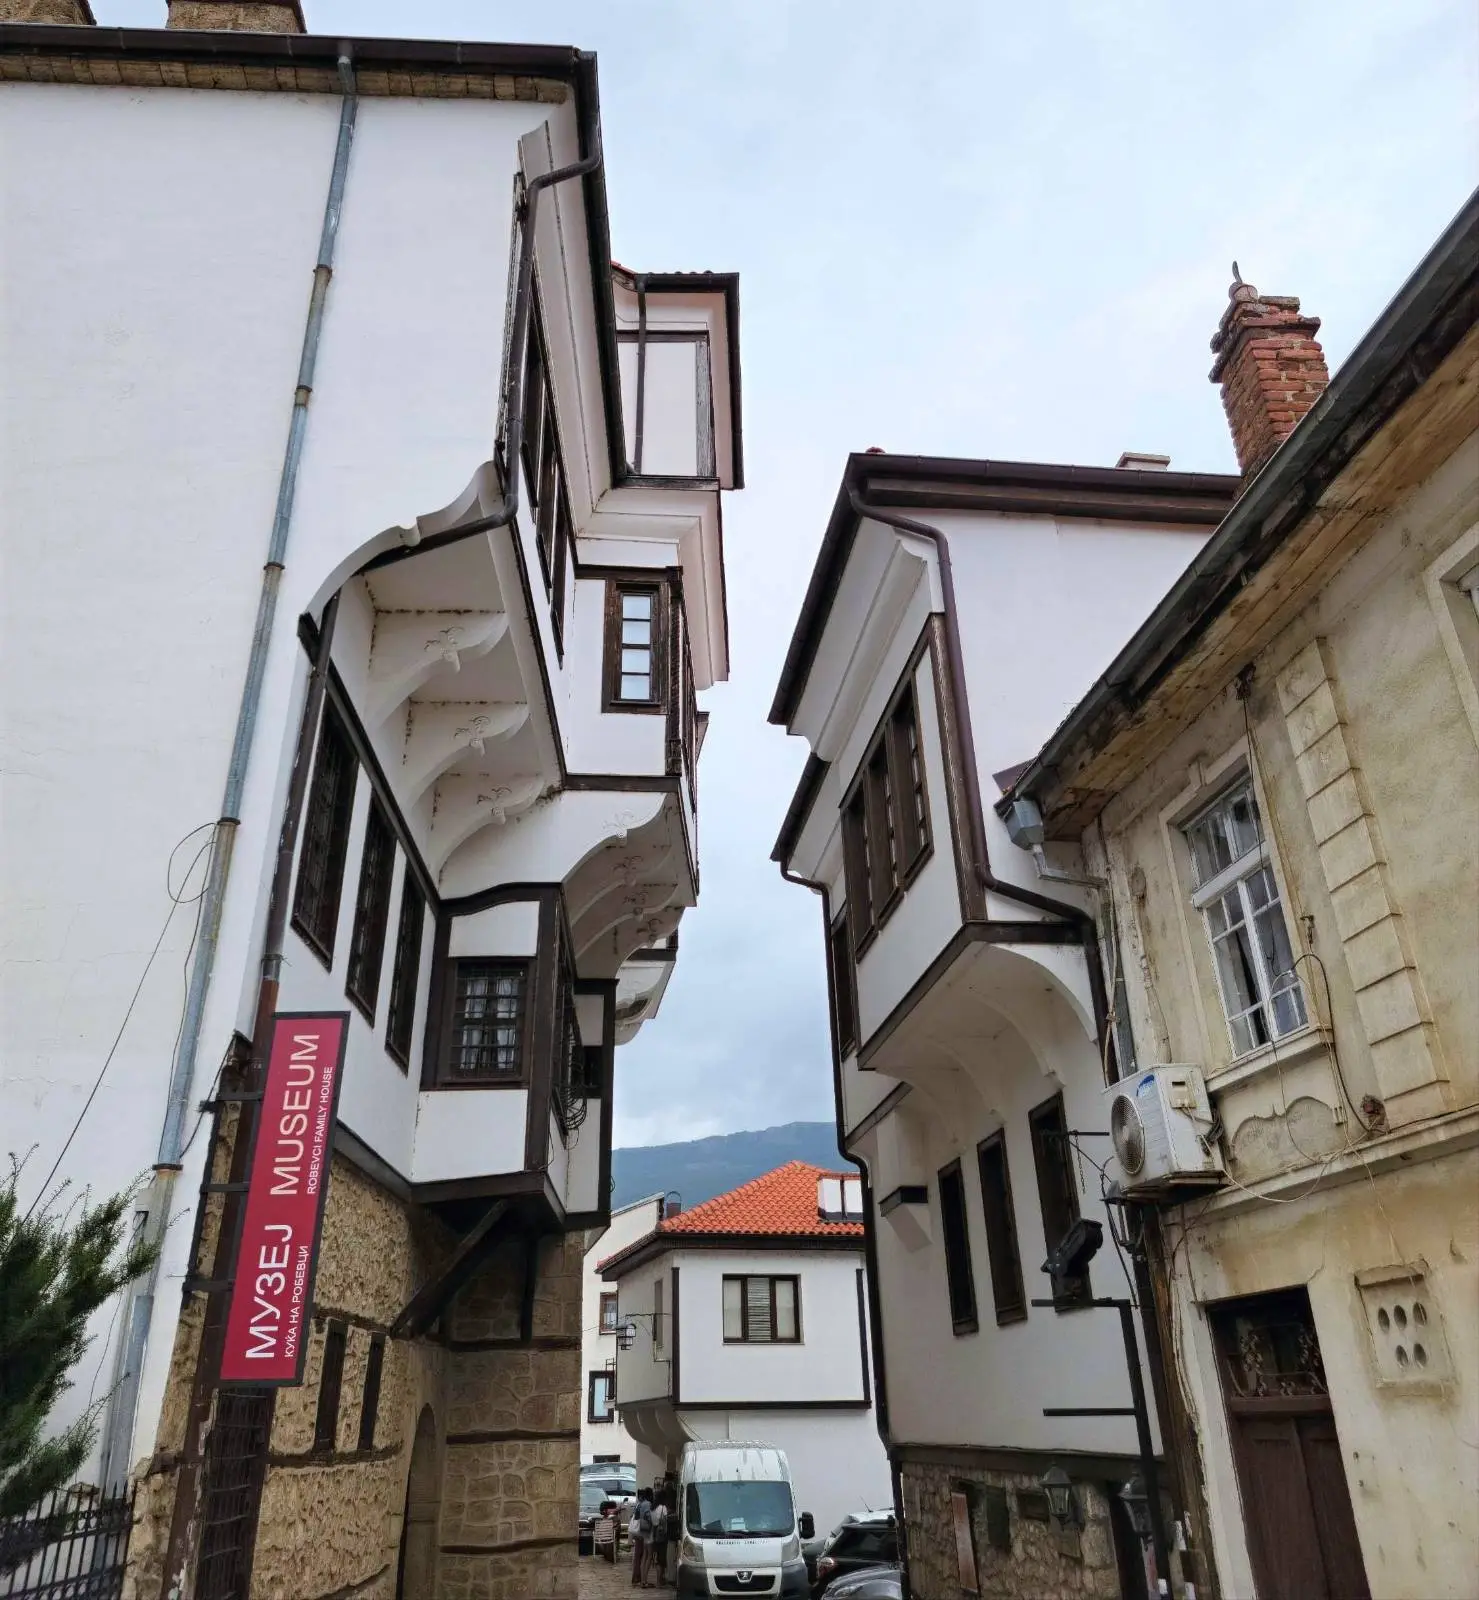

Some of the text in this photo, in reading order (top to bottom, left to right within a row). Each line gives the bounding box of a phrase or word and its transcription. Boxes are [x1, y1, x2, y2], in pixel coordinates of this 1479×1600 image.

[270, 1034, 320, 1195] MUSEUM
[307, 1066, 333, 1194] ROBEVCI FAMILY HOUSE
[245, 1224, 293, 1359] МУЗЕЈ
[289, 1306, 300, 1323] НА
[292, 1245, 309, 1303] РОБЕВЦИ
